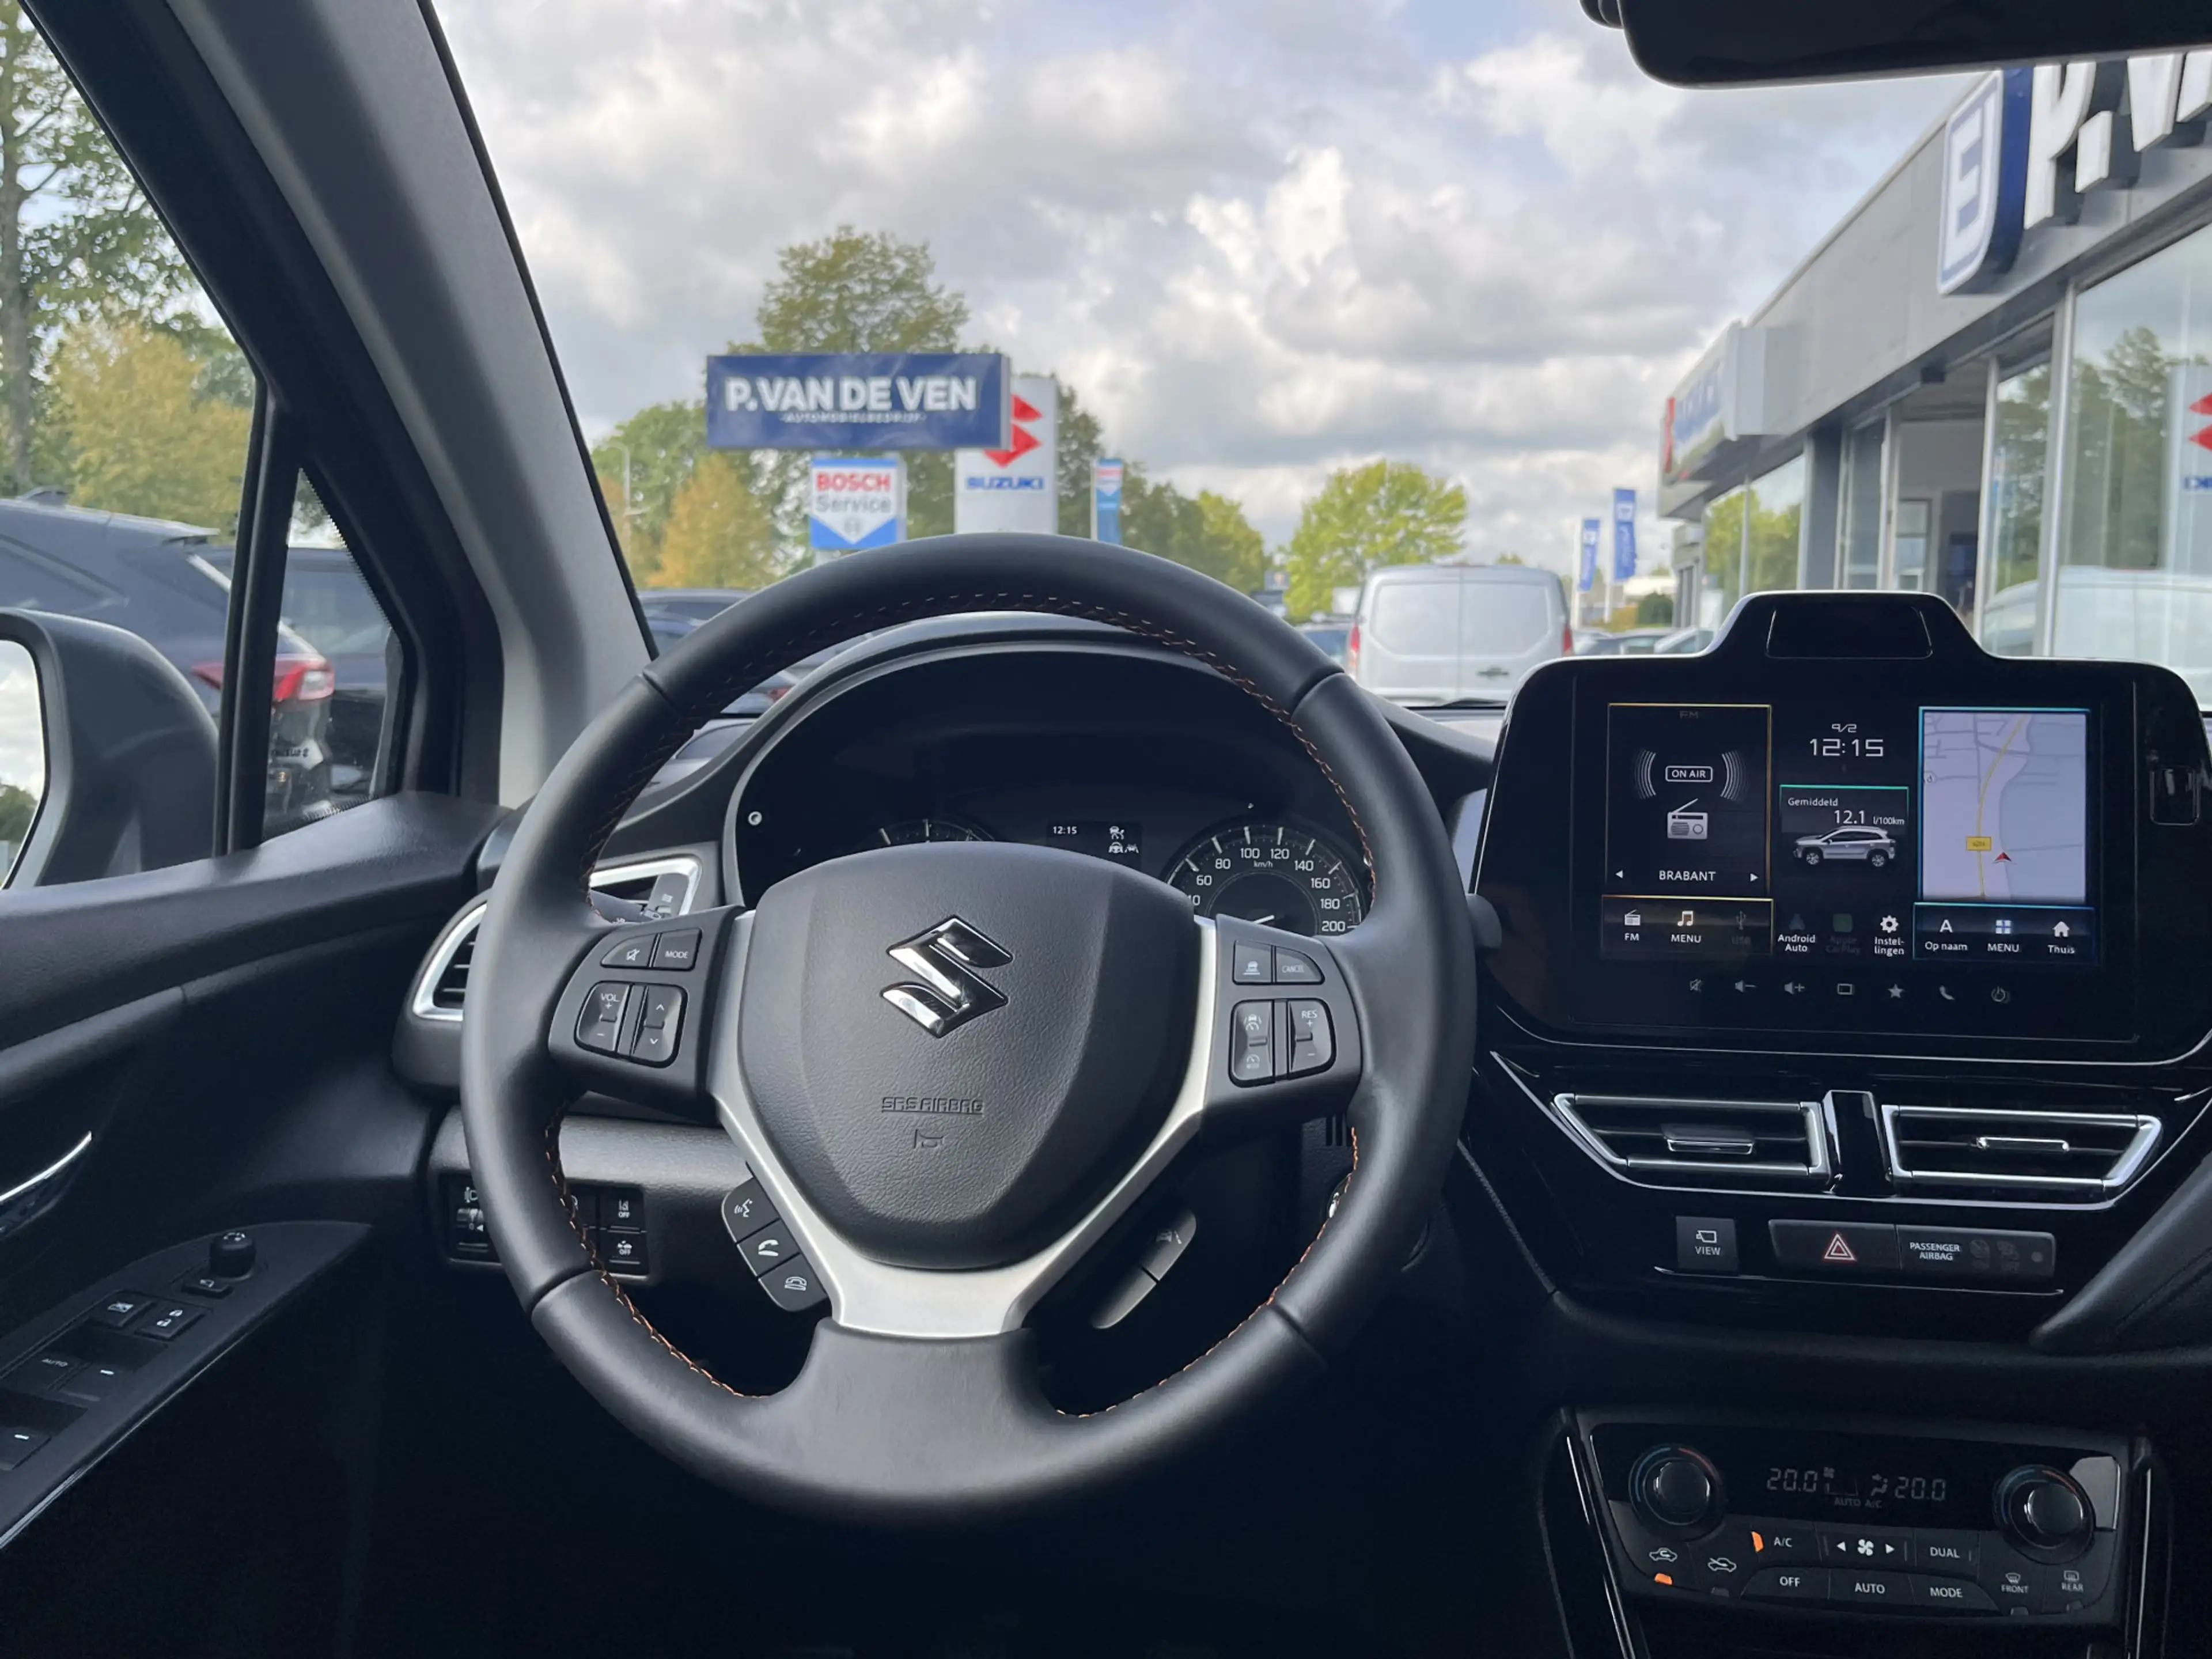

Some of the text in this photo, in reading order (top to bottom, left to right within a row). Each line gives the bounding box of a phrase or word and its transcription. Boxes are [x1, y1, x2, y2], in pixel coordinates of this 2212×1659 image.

[725, 377, 976, 411] P.VAN DE VEN
[817, 473, 891, 492] BOSCH
[967, 476, 1044, 491] SUZUKI
[815, 494, 892, 513] Service
[1809, 738, 1884, 757] 12:15
[1671, 770, 1706, 779] ON AIR
[1787, 797, 1839, 807] Gemiddeld
[1833, 810, 1866, 824] 12.1
[1052, 826, 1078, 835] 12:15
[1240, 848, 1290, 859] 100 120
[1215, 859, 1231, 869] 80
[1294, 861, 1315, 872] 140
[1658, 870, 1717, 882] BRABANT
[1196, 875, 1331, 889] 60 160
[1320, 898, 1340, 910] 180
[1321, 921, 1346, 932] 200
[1624, 933, 1640, 942] FM
[1671, 934, 1702, 944] MENU
[1777, 934, 1816, 944] Android
[1874, 936, 1905, 946] Instel-
[1784, 944, 1808, 953] Auto
[1874, 946, 1905, 956] lingen
[1925, 941, 1968, 953] Op naam
[1987, 943, 2020, 953] MENU
[2047, 944, 2075, 954] Thuis
[664, 950, 689, 959] MODE
[600, 993, 620, 1003] VOL
[1301, 1010, 1318, 1019] RES
[1694, 1246, 1721, 1256] VIEW
[1909, 1241, 1961, 1252] PASSENGER
[1919, 1251, 1954, 1262] AIRBAG
[1766, 1467, 1818, 1493] 20.0
[1894, 1476, 1946, 1502] 20.0
[1834, 1497, 1862, 1508] AUTO
[1774, 1537, 1793, 1548] A/C
[1930, 1547, 1961, 1559] DUAL
[1779, 1576, 1801, 1588] OFF
[2061, 1582, 2084, 1593] REAR
[1854, 1582, 1885, 1594] AUTO
[1930, 1587, 1963, 1598] MODE
[2001, 1584, 2029, 1594] FRONT
